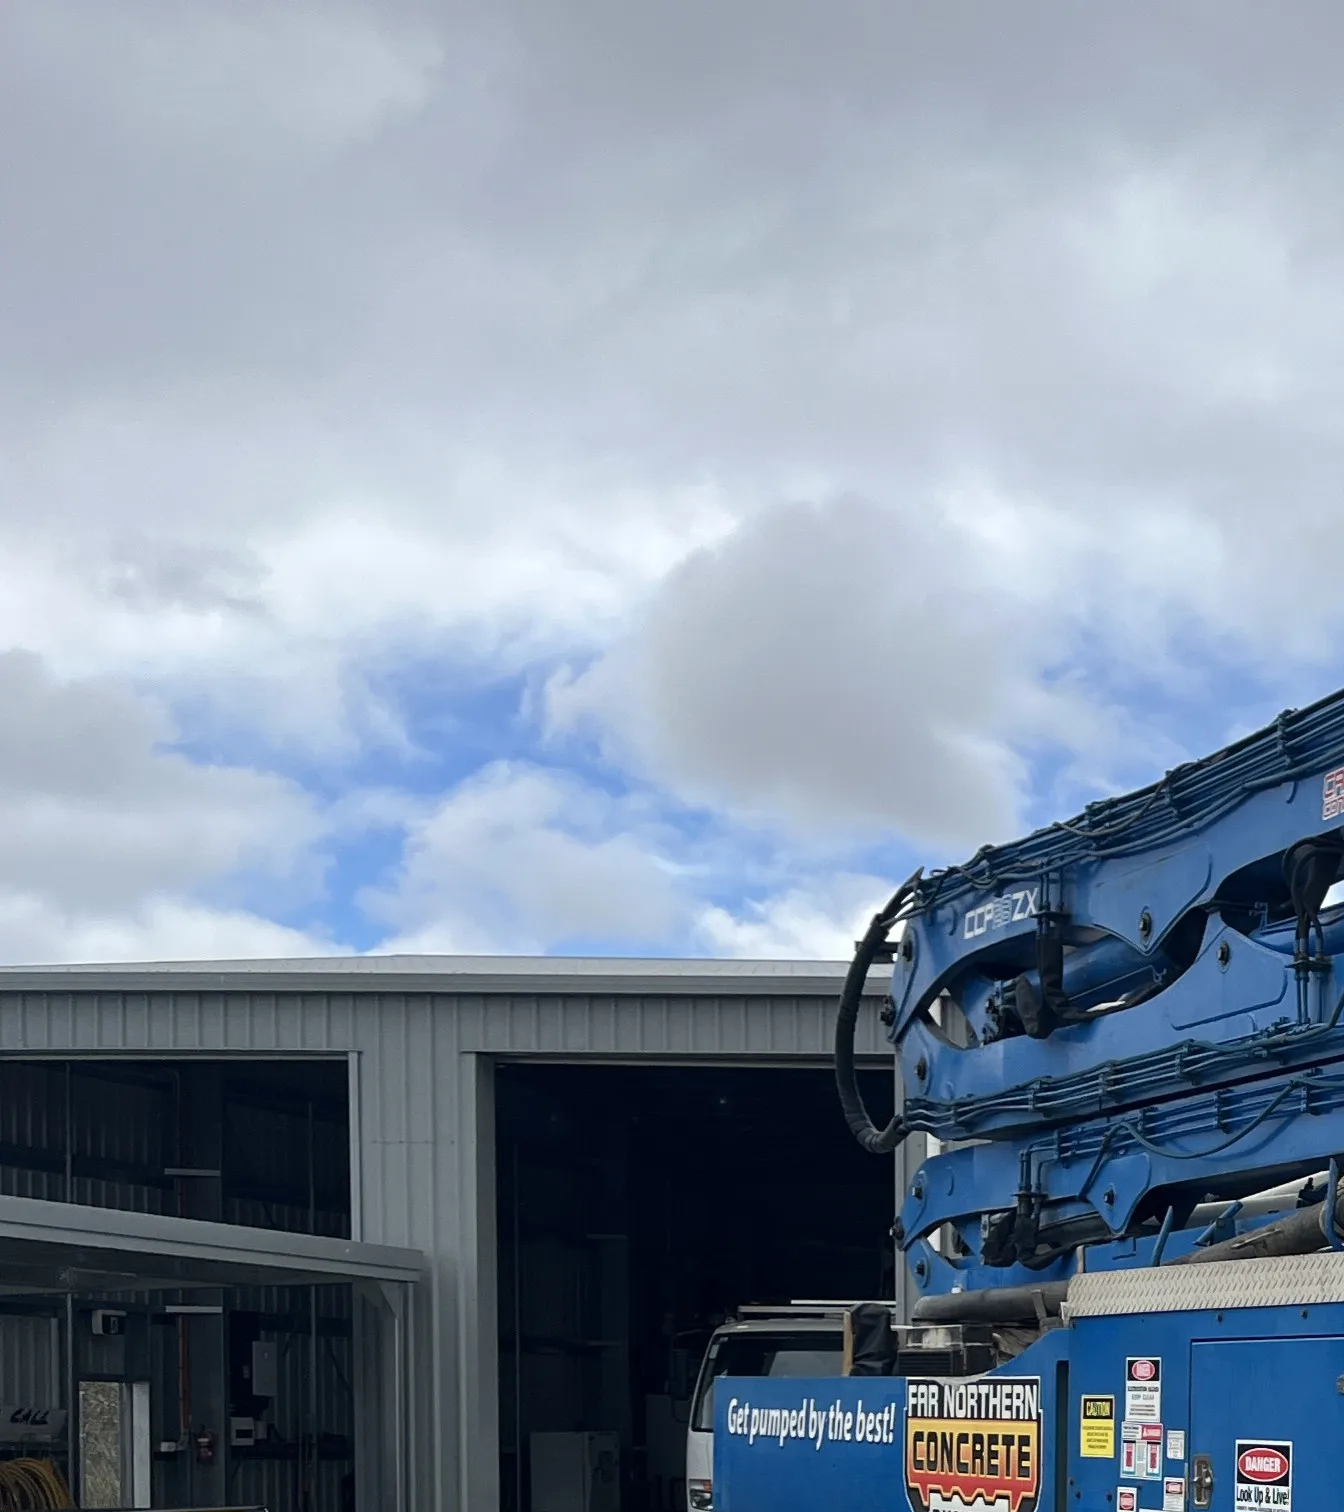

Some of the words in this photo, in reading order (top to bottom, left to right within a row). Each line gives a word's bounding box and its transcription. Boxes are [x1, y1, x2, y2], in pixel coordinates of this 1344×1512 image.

[908, 1384, 939, 1417] FAR
[943, 1384, 1038, 1420] NORTHERN
[727, 1398, 750, 1435] Get
[748, 1398, 808, 1447] pumped
[808, 1398, 827, 1451] by
[828, 1399, 853, 1441] the
[855, 1399, 896, 1444] best!
[913, 1431, 1031, 1478] CONCRETE
[1245, 1455, 1281, 1473] DANGER
[1236, 1486, 1253, 1502] Look
[1254, 1486, 1264, 1507] Up
[1265, 1487, 1271, 1504] &
[1272, 1487, 1290, 1506] Live!
